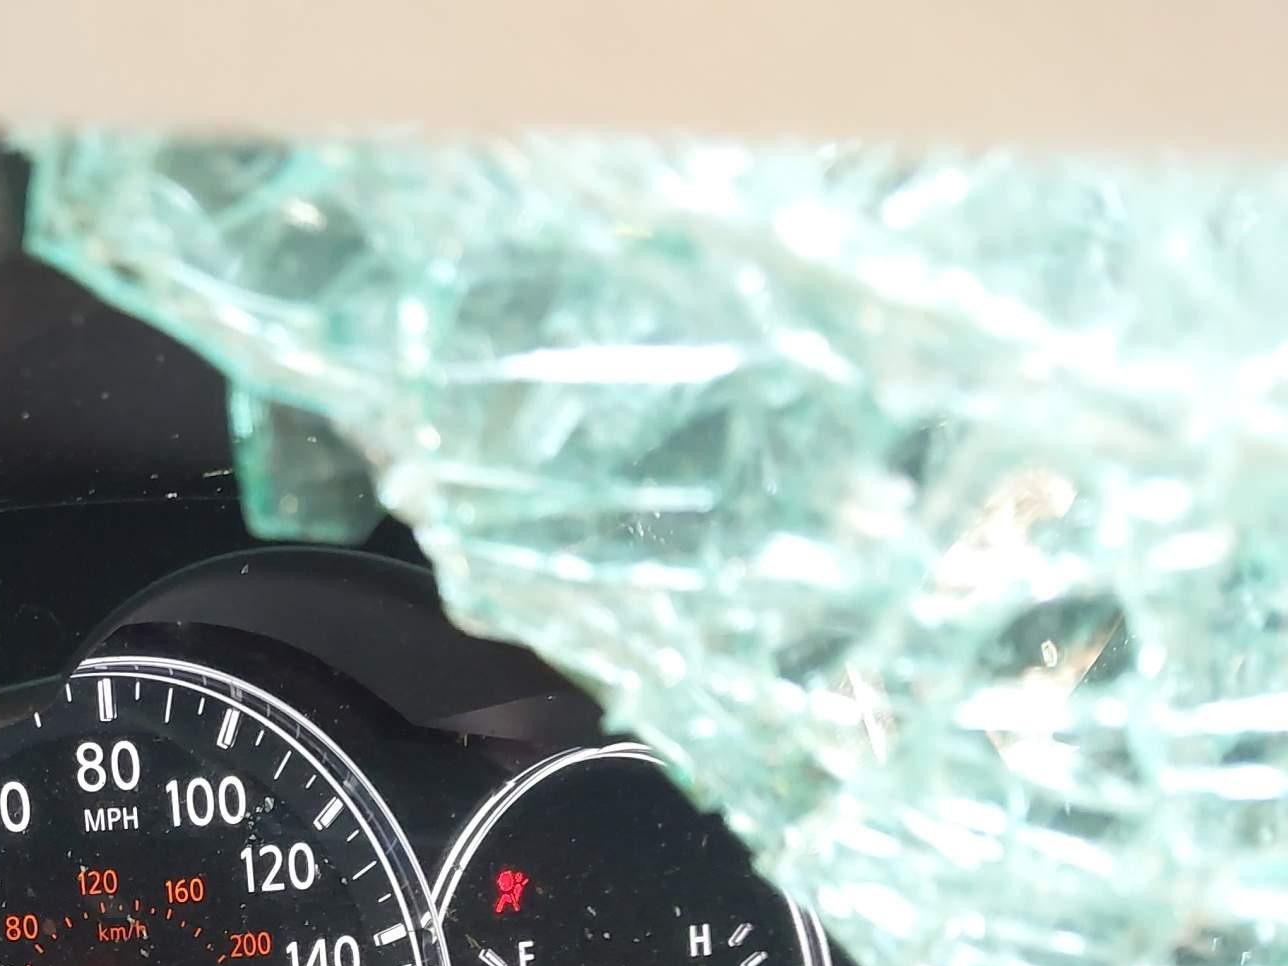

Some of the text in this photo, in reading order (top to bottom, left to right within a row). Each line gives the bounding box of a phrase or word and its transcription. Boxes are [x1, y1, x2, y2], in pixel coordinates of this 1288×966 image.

[75, 740, 141, 793] 80
[165, 775, 247, 827] 100
[84, 806, 139, 832] MPH
[240, 842, 315, 893] 120
[78, 869, 118, 895] 120
[165, 878, 204, 903] 160
[5, 914, 38, 941] 80
[98, 920, 147, 942] km/h
[689, 923, 712, 957] H
[230, 931, 271, 958] 200
